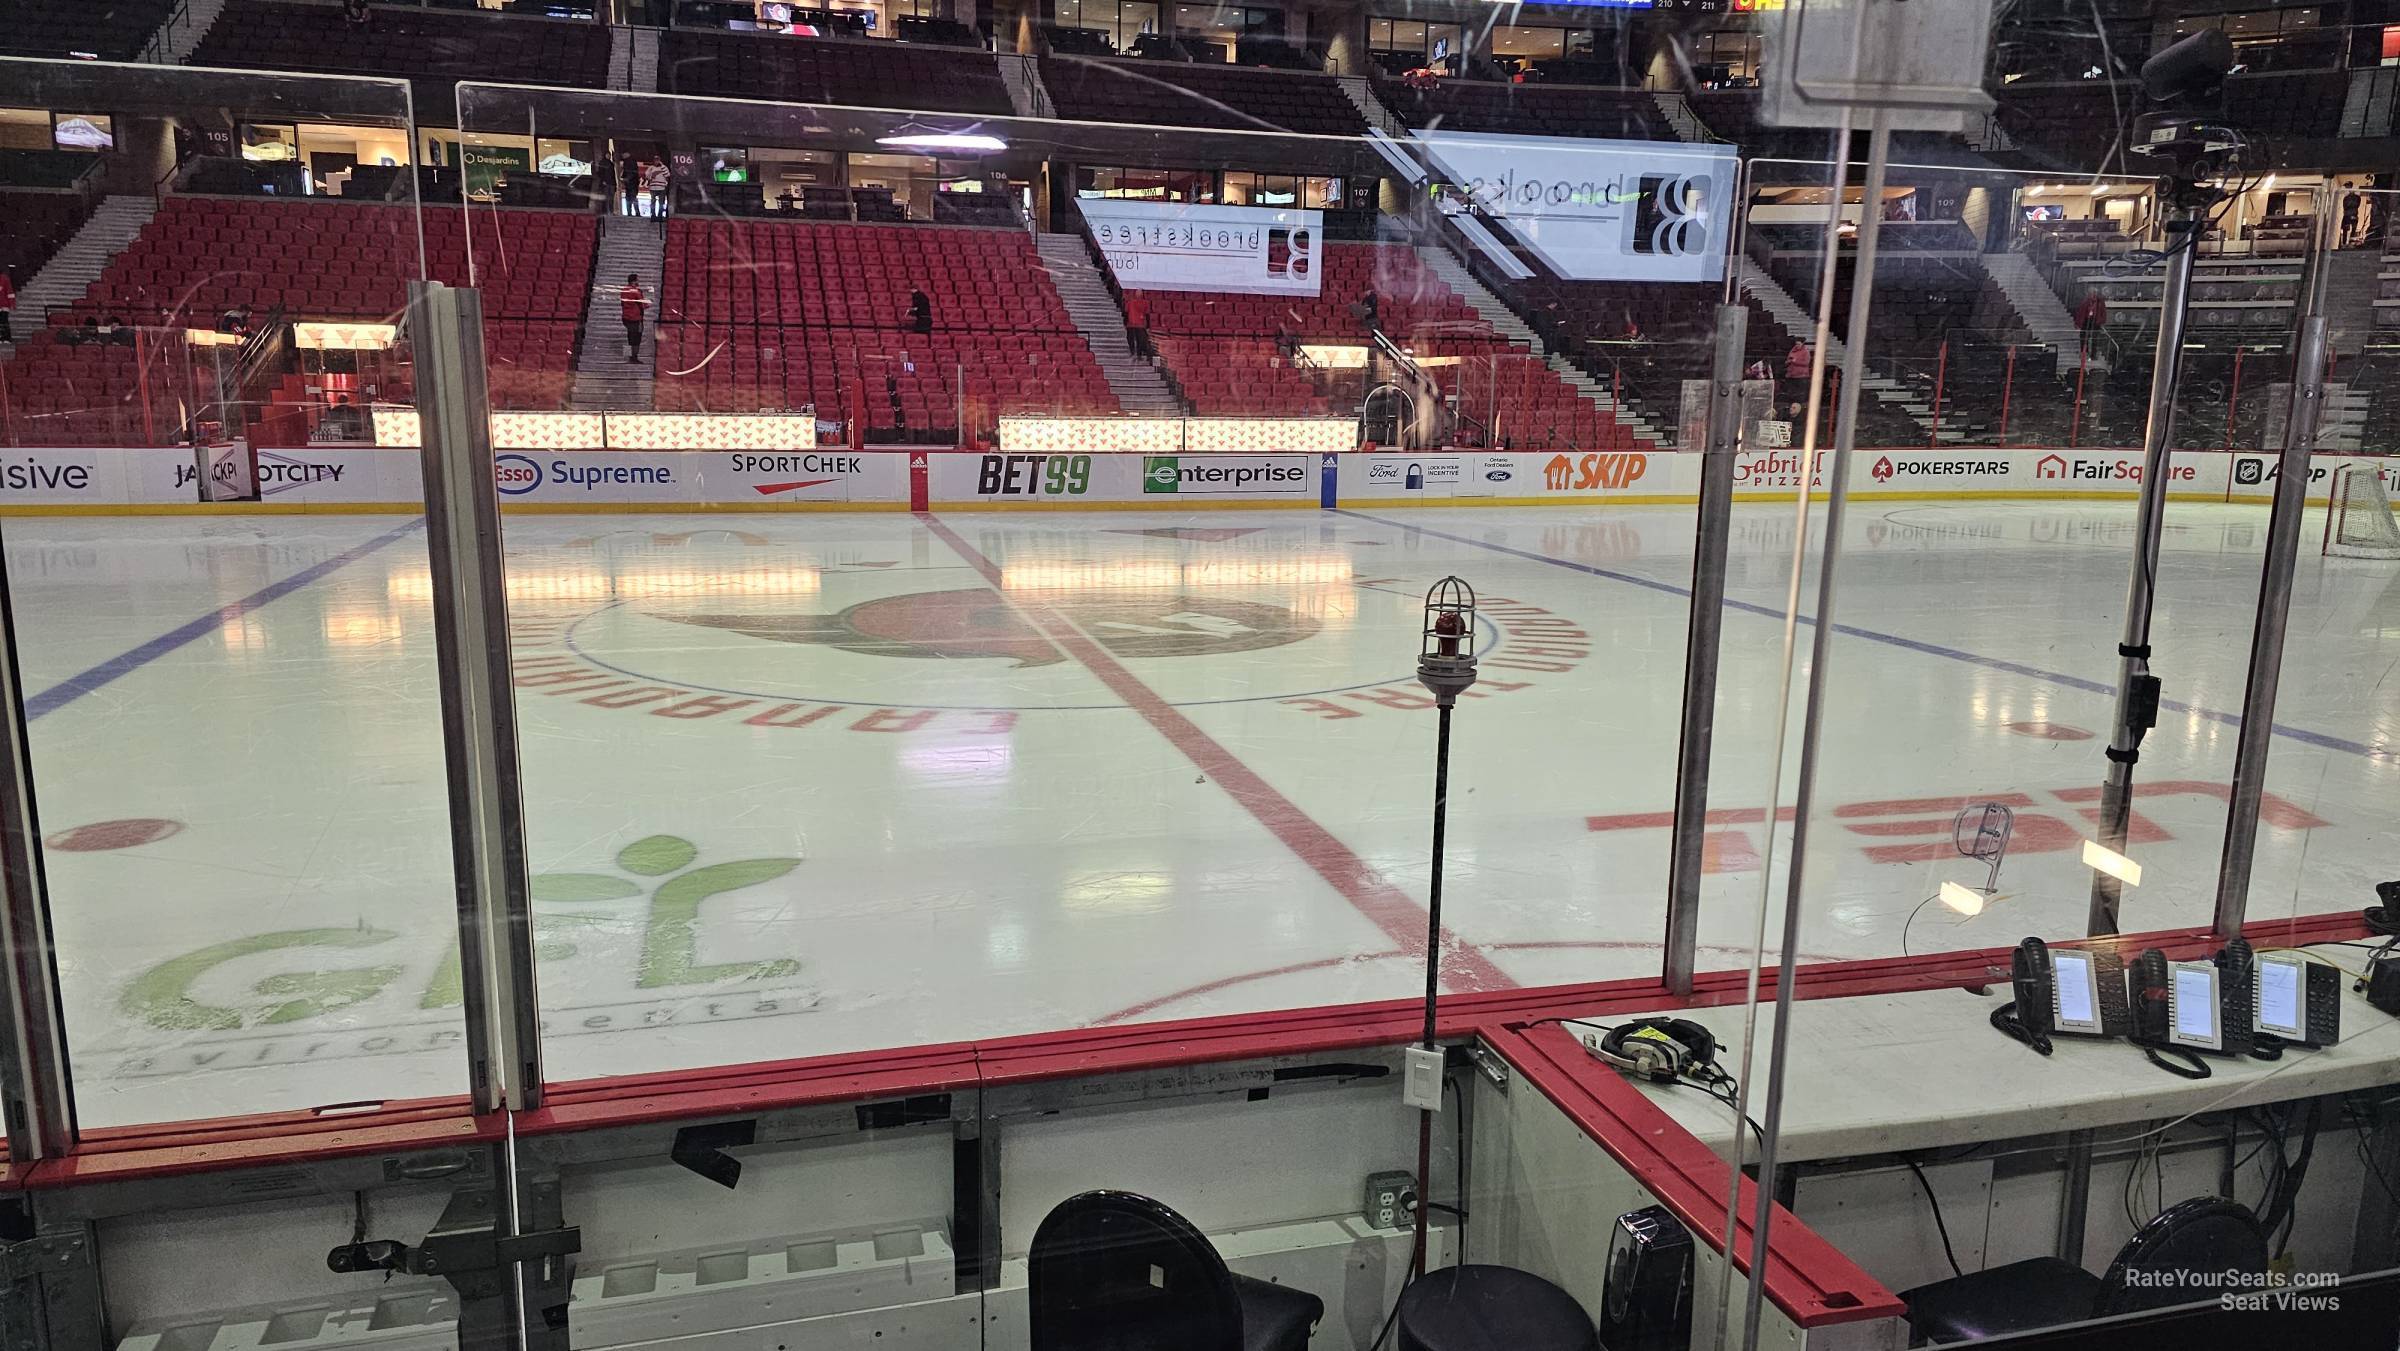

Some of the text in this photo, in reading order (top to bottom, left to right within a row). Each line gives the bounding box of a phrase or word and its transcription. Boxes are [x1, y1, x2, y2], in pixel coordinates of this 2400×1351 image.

[1658, 0, 1673, 8] 210
[1701, 2, 1715, 10] 211
[207, 132, 229, 141] 105
[476, 155, 520, 166] Desjardins
[673, 155, 693, 164] 106
[989, 171, 1008, 180] 106
[1353, 189, 1369, 197] 107
[1153, 457, 1304, 488] enterprise
[1369, 464, 1400, 479] Ford
[1573, 453, 1648, 490] SKIP
[1897, 460, 2010, 475] POKERSTARS
[2072, 459, 2196, 485] FairSqre
[977, 455, 1092, 495] BET99
